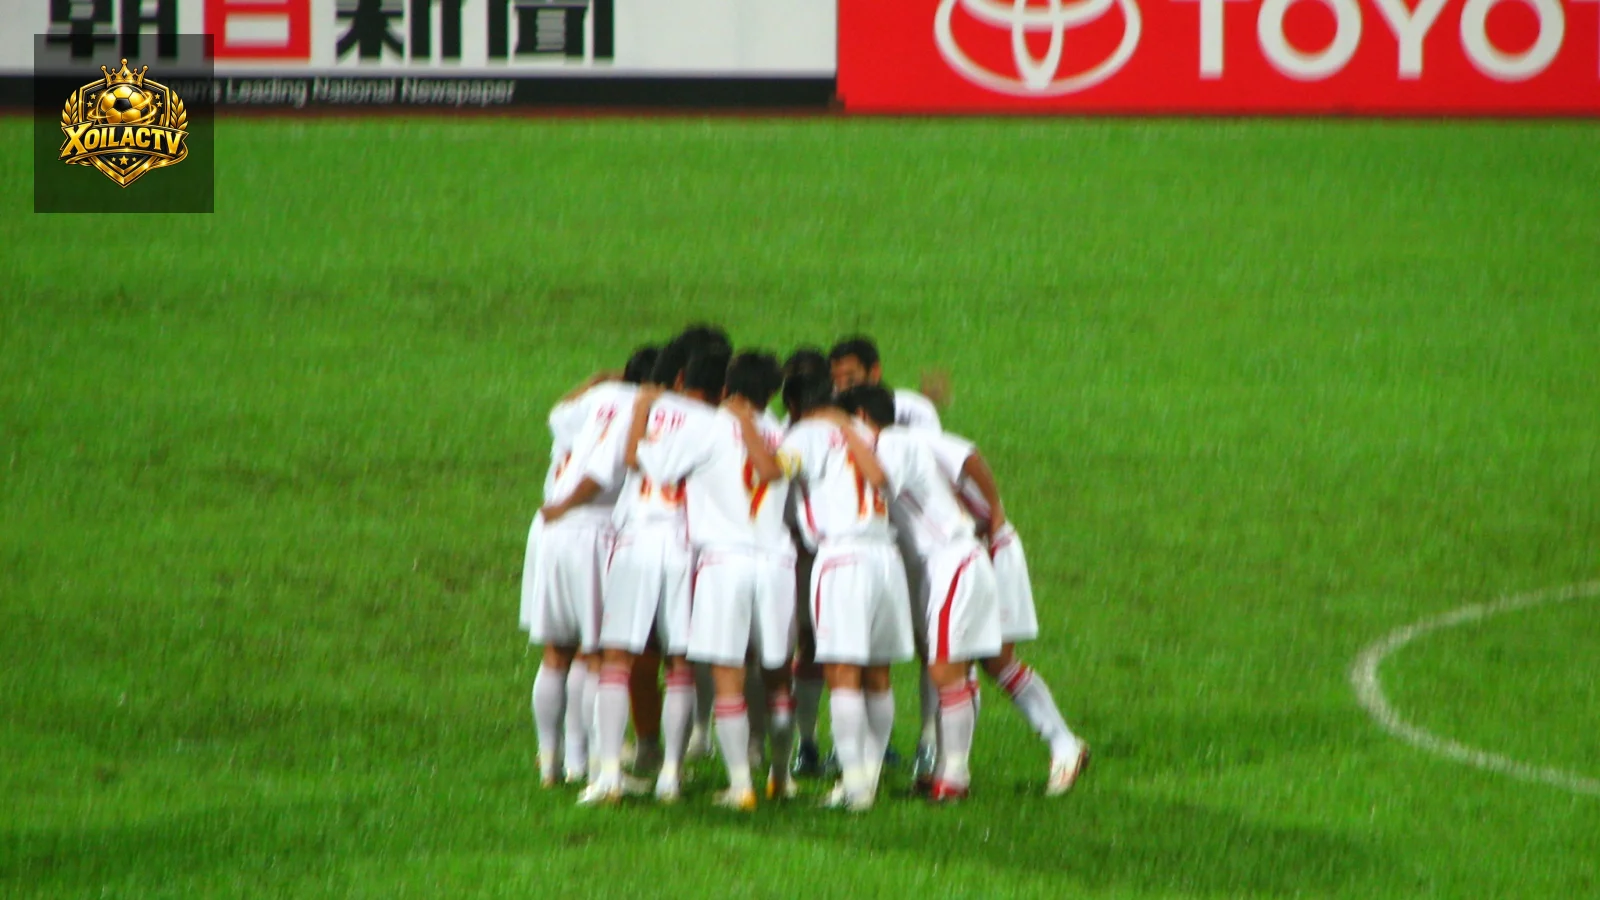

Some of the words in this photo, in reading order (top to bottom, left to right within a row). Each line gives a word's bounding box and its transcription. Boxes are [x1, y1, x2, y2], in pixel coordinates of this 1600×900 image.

[1170, 0, 1600, 82] TOYO
[226, 77, 307, 108] Leading
[313, 77, 396, 104] National
[401, 77, 515, 108] Newspaper
